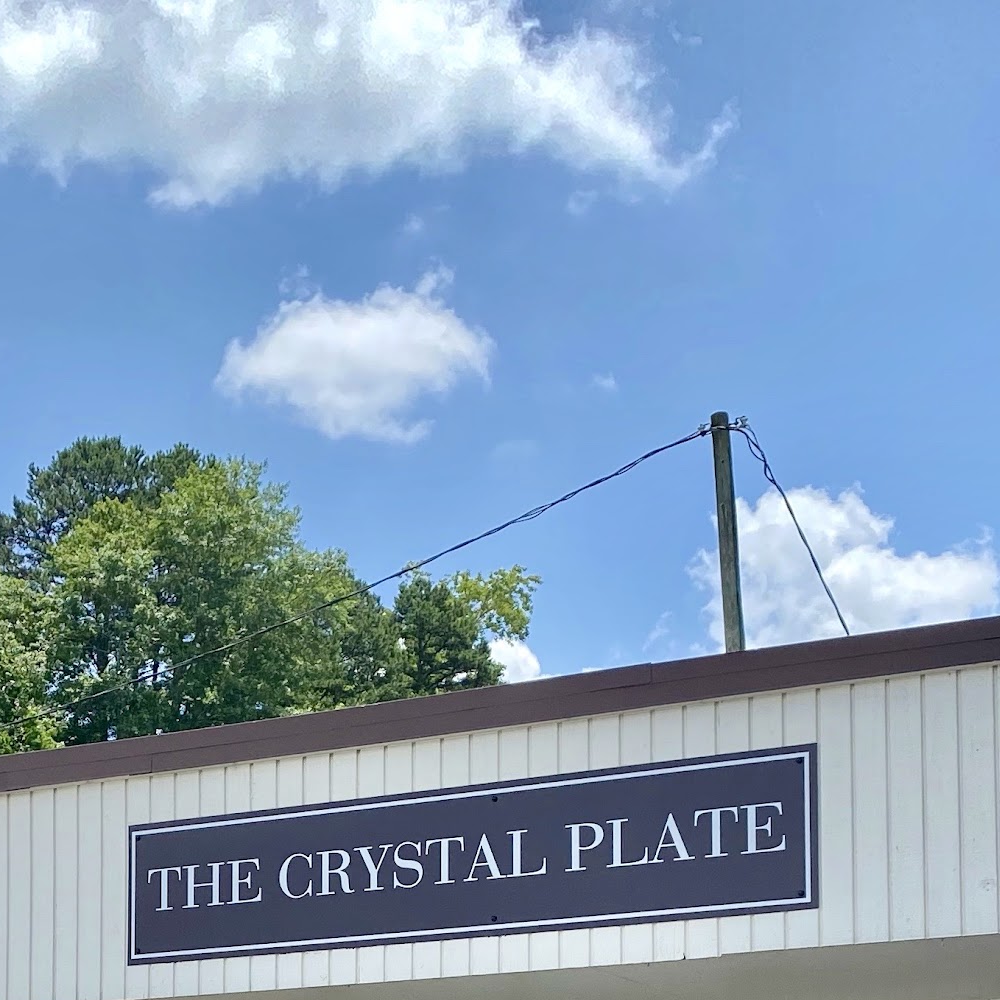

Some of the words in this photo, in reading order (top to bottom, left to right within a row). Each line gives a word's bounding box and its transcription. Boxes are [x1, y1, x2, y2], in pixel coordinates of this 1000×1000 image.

[147, 858, 262, 912] THE
[278, 829, 548, 899] CRYSTAL
[564, 801, 787, 873] PLATE
